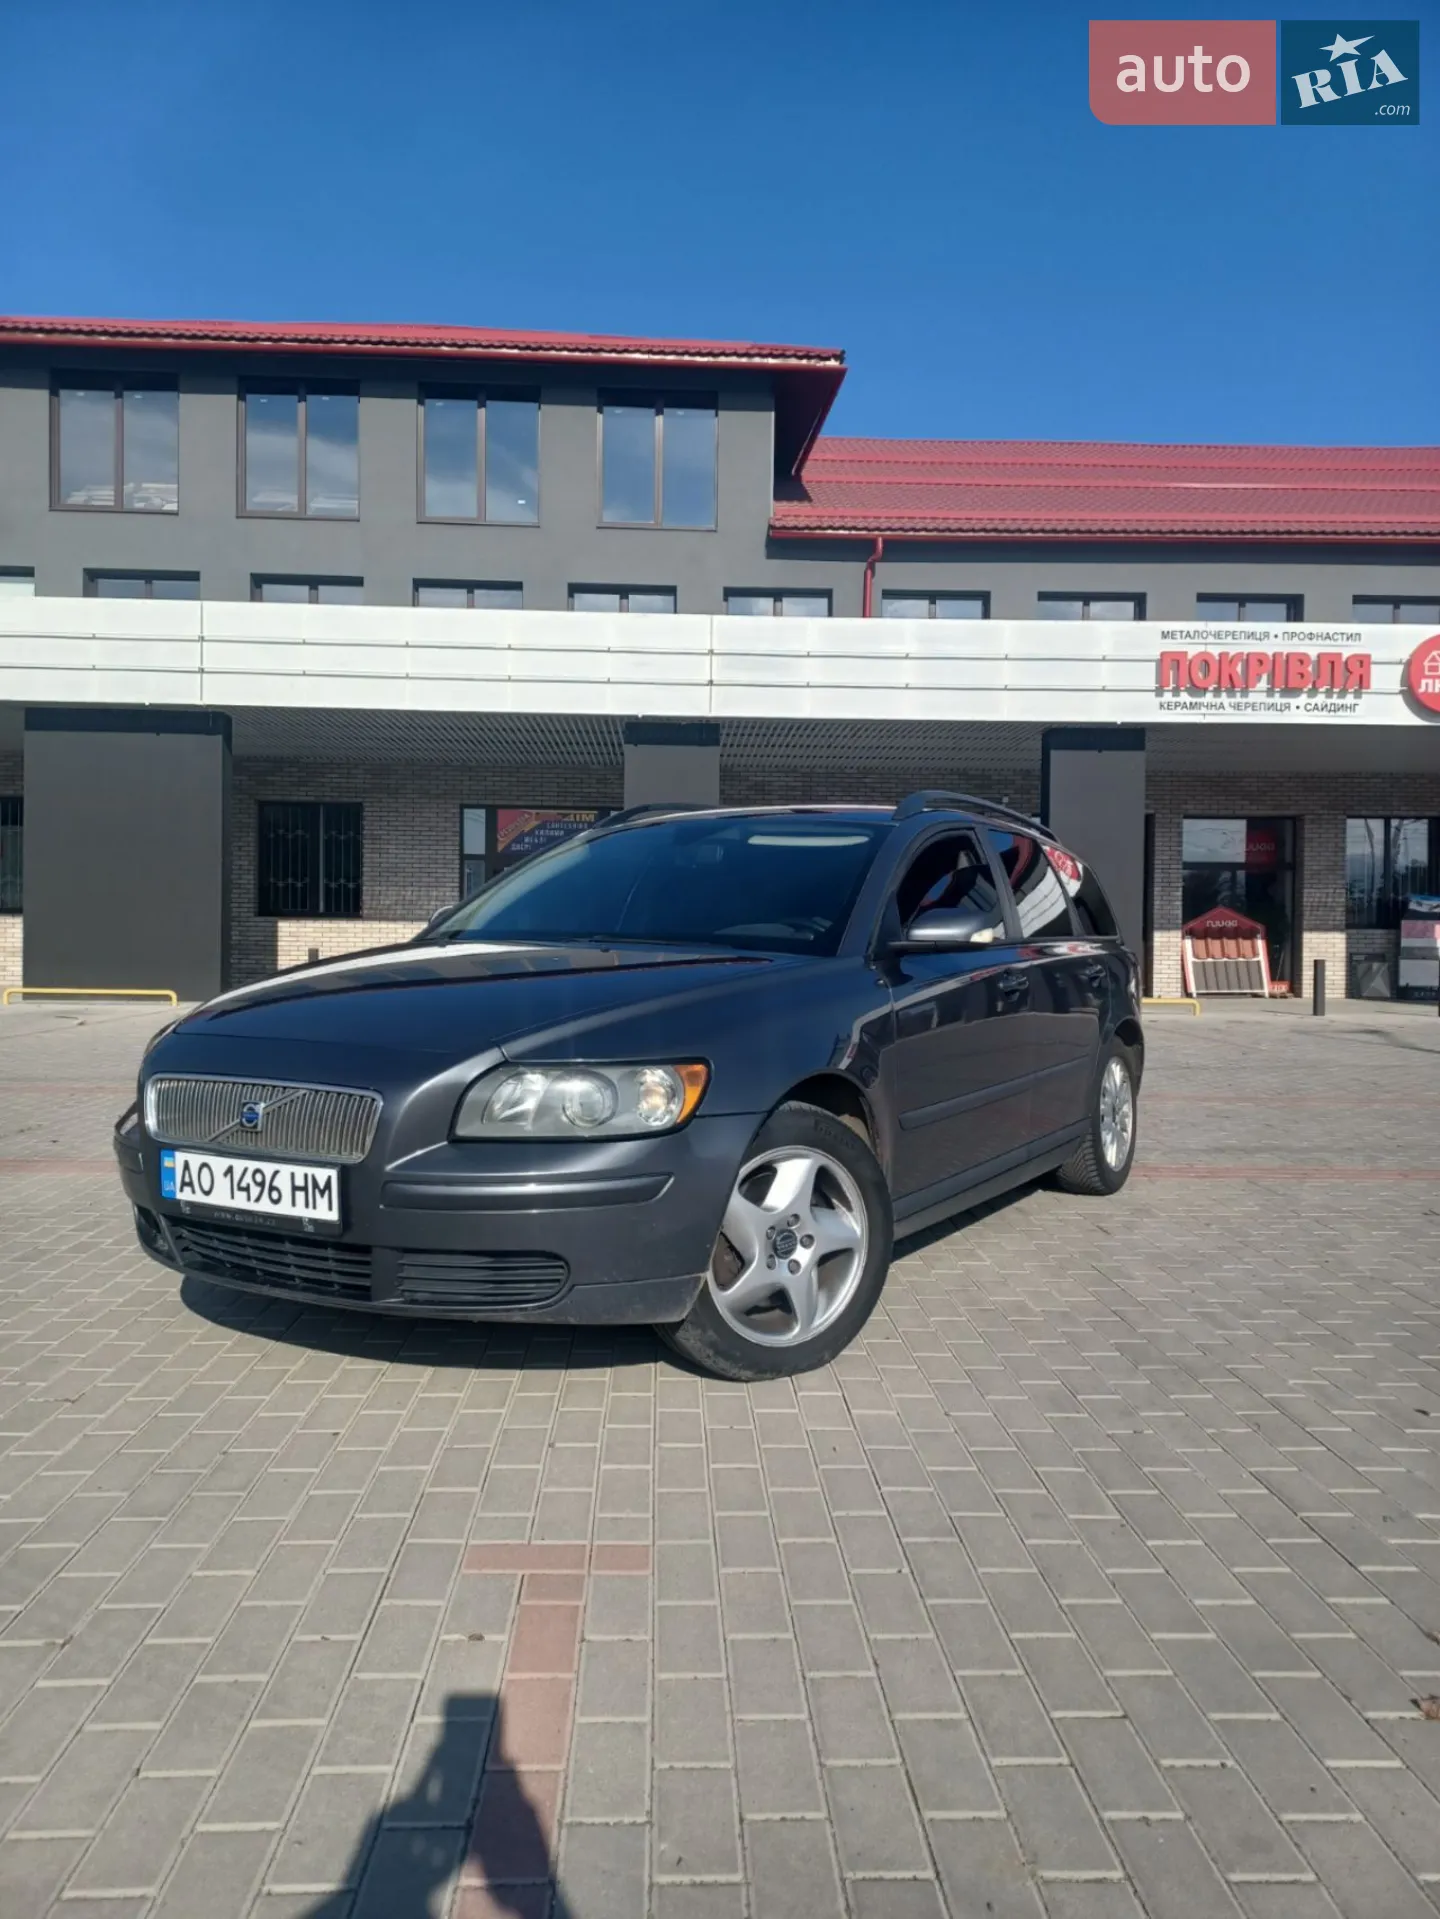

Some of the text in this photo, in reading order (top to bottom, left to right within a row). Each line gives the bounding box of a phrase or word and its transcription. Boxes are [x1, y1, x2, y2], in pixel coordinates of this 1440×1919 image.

[1160, 630, 1362, 643] МЕТАЛОЧЕРЕПИЦЯ ПРОФНАСТИЛ
[1159, 650, 1372, 691] ПОКРІВЛЯ
[1159, 701, 1360, 713] КЕРАМІЧНА ЧЕРЕПИЦЯ САЙДИНГ
[179, 1159, 333, 1212] AO 1496 HM
